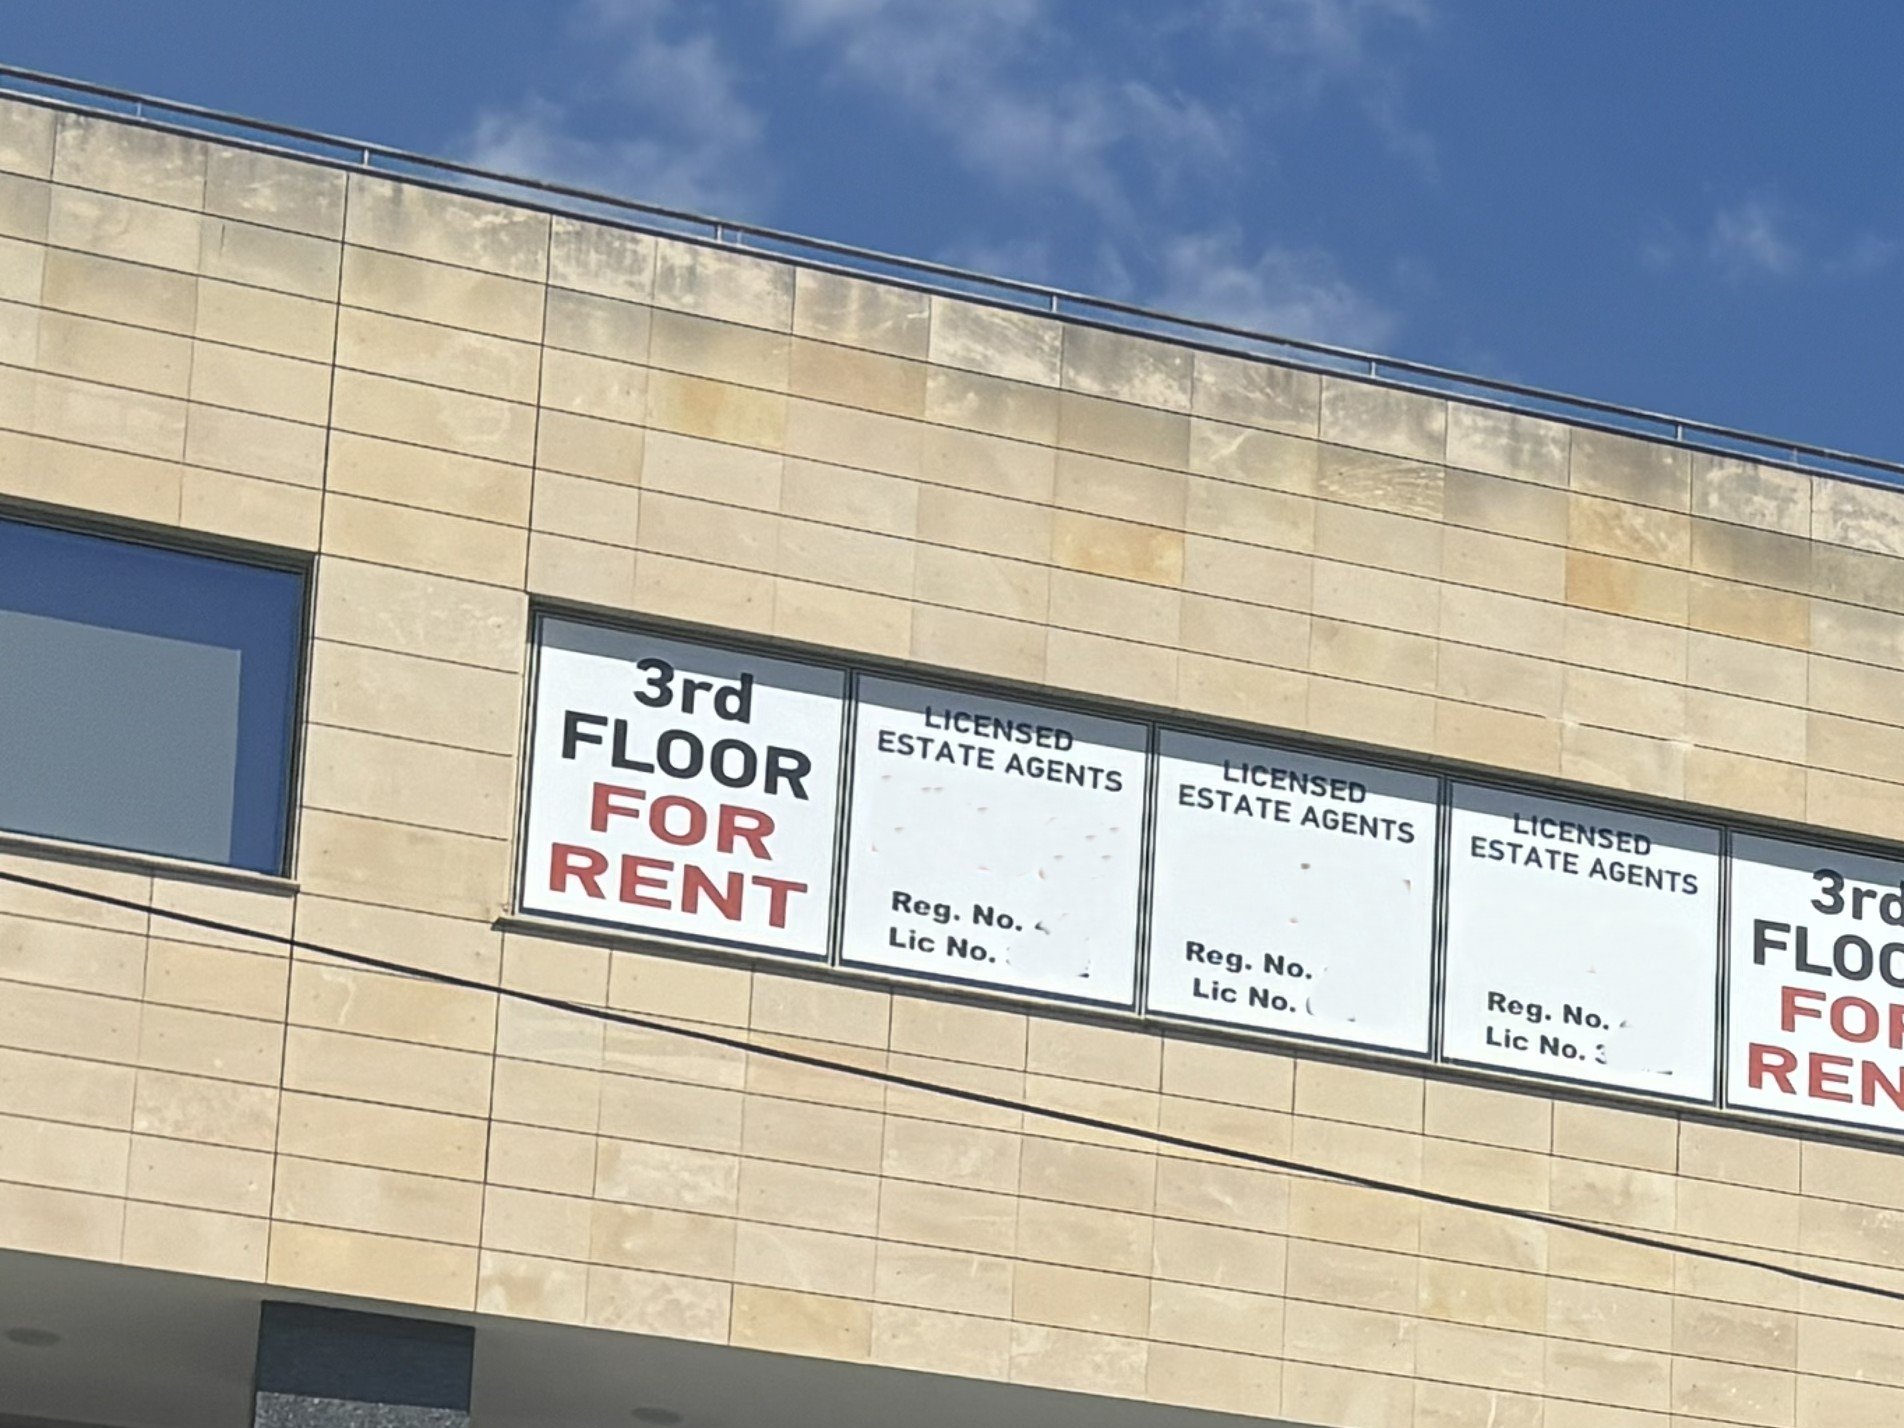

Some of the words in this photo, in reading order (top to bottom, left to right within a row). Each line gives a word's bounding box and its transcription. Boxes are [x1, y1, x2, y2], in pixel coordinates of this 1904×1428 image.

[633, 657, 755, 724] 3rd
[925, 706, 1074, 752] LICENSED
[561, 710, 812, 800] FLOOR
[878, 730, 995, 771] ESTATE
[1004, 752, 1124, 793] AGENTS
[1223, 760, 1367, 804] LICENSED
[591, 782, 775, 860] FOR
[1178, 784, 1292, 823] ESTATE
[1300, 806, 1416, 844] AGENTS
[1513, 812, 1651, 856] LICENSED
[549, 842, 808, 929] RENT
[1470, 835, 1579, 875] ESTATE
[1589, 857, 1699, 895] AGENTS
[891, 891, 962, 926] Reg.
[972, 903, 1023, 933] No.
[889, 927, 935, 955] Lic
[946, 936, 997, 964] No.
[1185, 940, 1252, 973] Reg.
[1263, 953, 1313, 980] No.
[1192, 977, 1238, 1003] Lic
[1248, 986, 1297, 1013] No.
[1487, 991, 1552, 1024] Reg.
[1563, 1003, 1609, 1030] No.
[1486, 1025, 1529, 1051] Lic
[1540, 1034, 1586, 1061] No.
